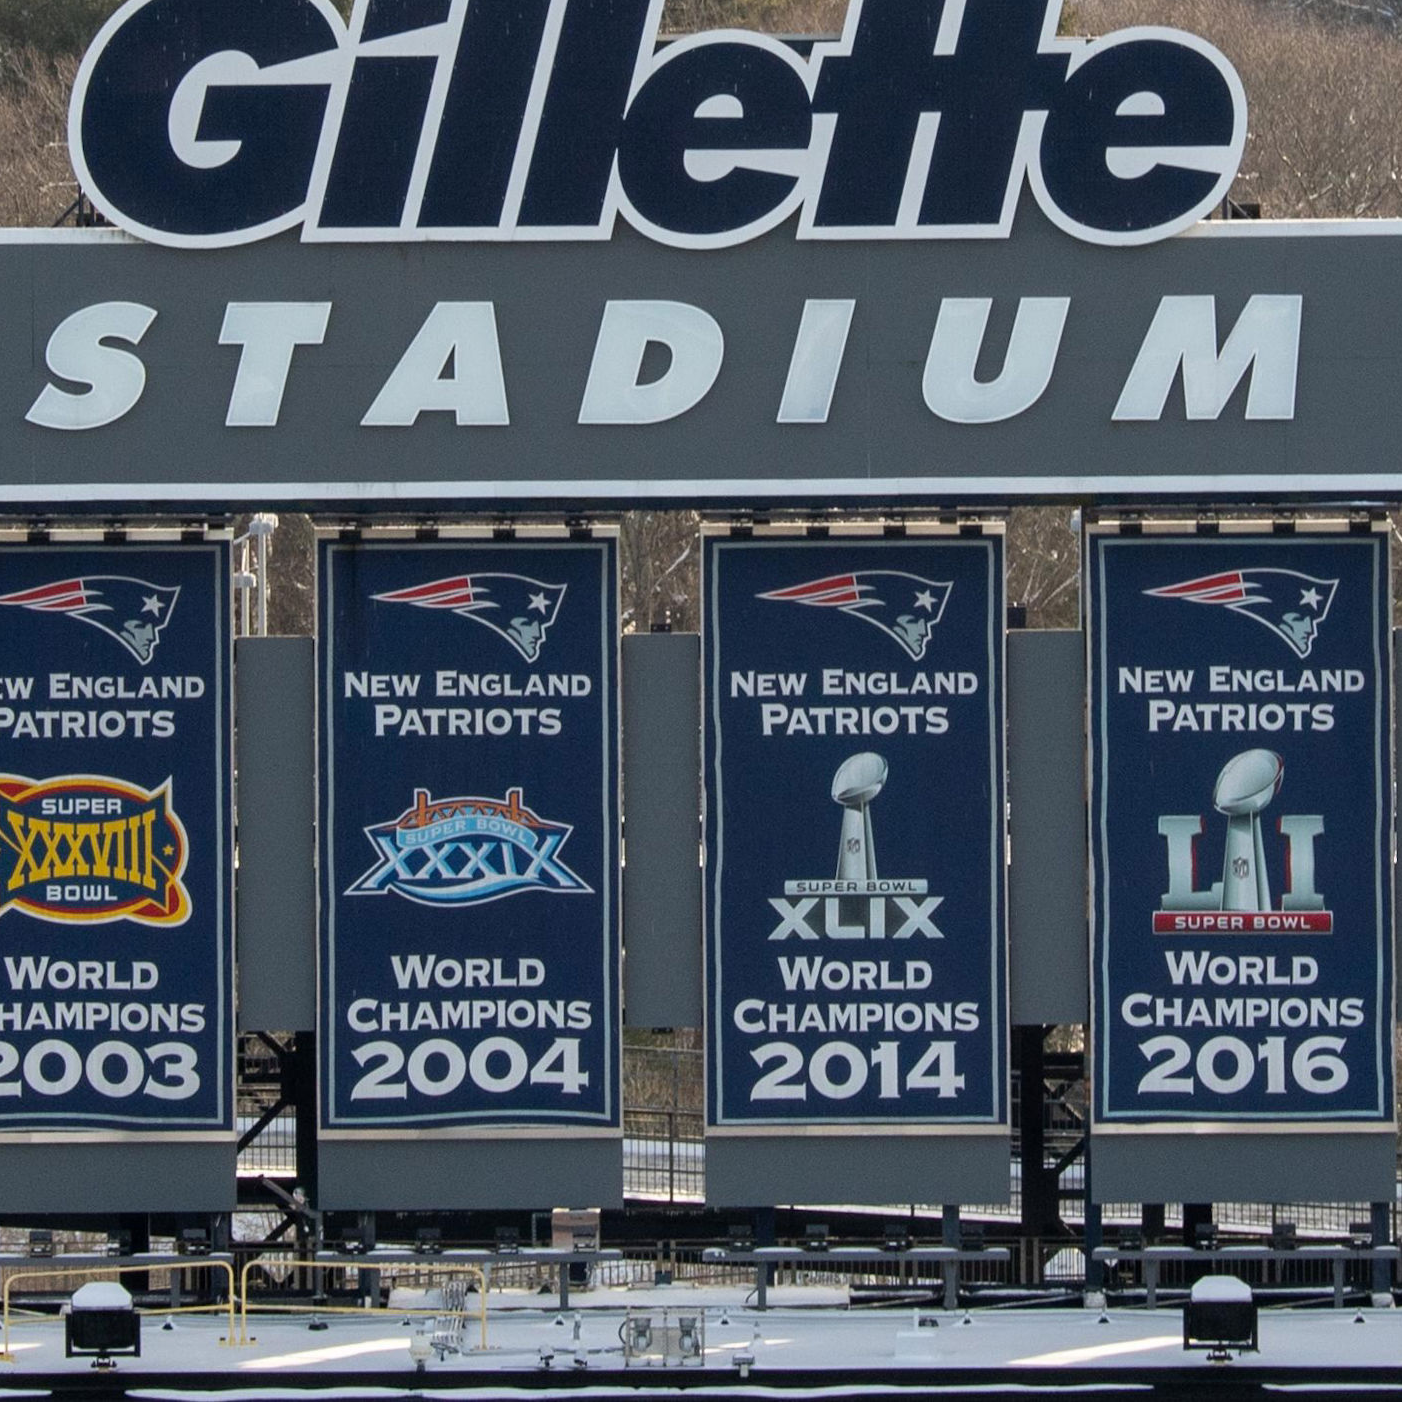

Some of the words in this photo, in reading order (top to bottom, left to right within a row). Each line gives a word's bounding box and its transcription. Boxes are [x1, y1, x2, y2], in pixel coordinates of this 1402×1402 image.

[24, 294, 1303, 432] STADIUM
[49, 672, 205, 699] ENGLAND
[344, 671, 421, 698] NEW
[435, 670, 592, 697] ENGLAND
[730, 670, 808, 698] NEW
[822, 668, 978, 695] ENGLAND
[1118, 666, 1195, 694] NEW
[1209, 665, 1365, 692] ENGLAND
[374, 704, 562, 737] PATRIOTS
[761, 703, 949, 736] PATRIOTS
[1148, 699, 1335, 732] PATRIOTS
[41, 798, 122, 815] SUPER
[404, 816, 467, 844] SUPER
[476, 817, 530, 843] BOWL
[6, 809, 157, 891] XXXVIII
[360, 835, 577, 889] XXXIX
[46, 884, 118, 901] BOWL
[796, 881, 858, 893] SUPER
[866, 880, 918, 892] BOWL
[767, 896, 945, 940] XLIX
[1174, 916, 1244, 930] SUPER
[1253, 915, 1312, 930] BOWL
[3, 956, 159, 991] WORLD
[390, 954, 546, 990] WORLD
[777, 956, 933, 991] WORLD
[1164, 950, 1319, 986] WORLD
[347, 998, 592, 1033] CHAMPIONS
[733, 998, 980, 1034] CHAMPIONS
[1121, 992, 1365, 1028] CHAMPIONS
[350, 1036, 589, 1101] 2004
[749, 1040, 966, 1102] 2014
[1137, 1035, 1349, 1095] 2016
